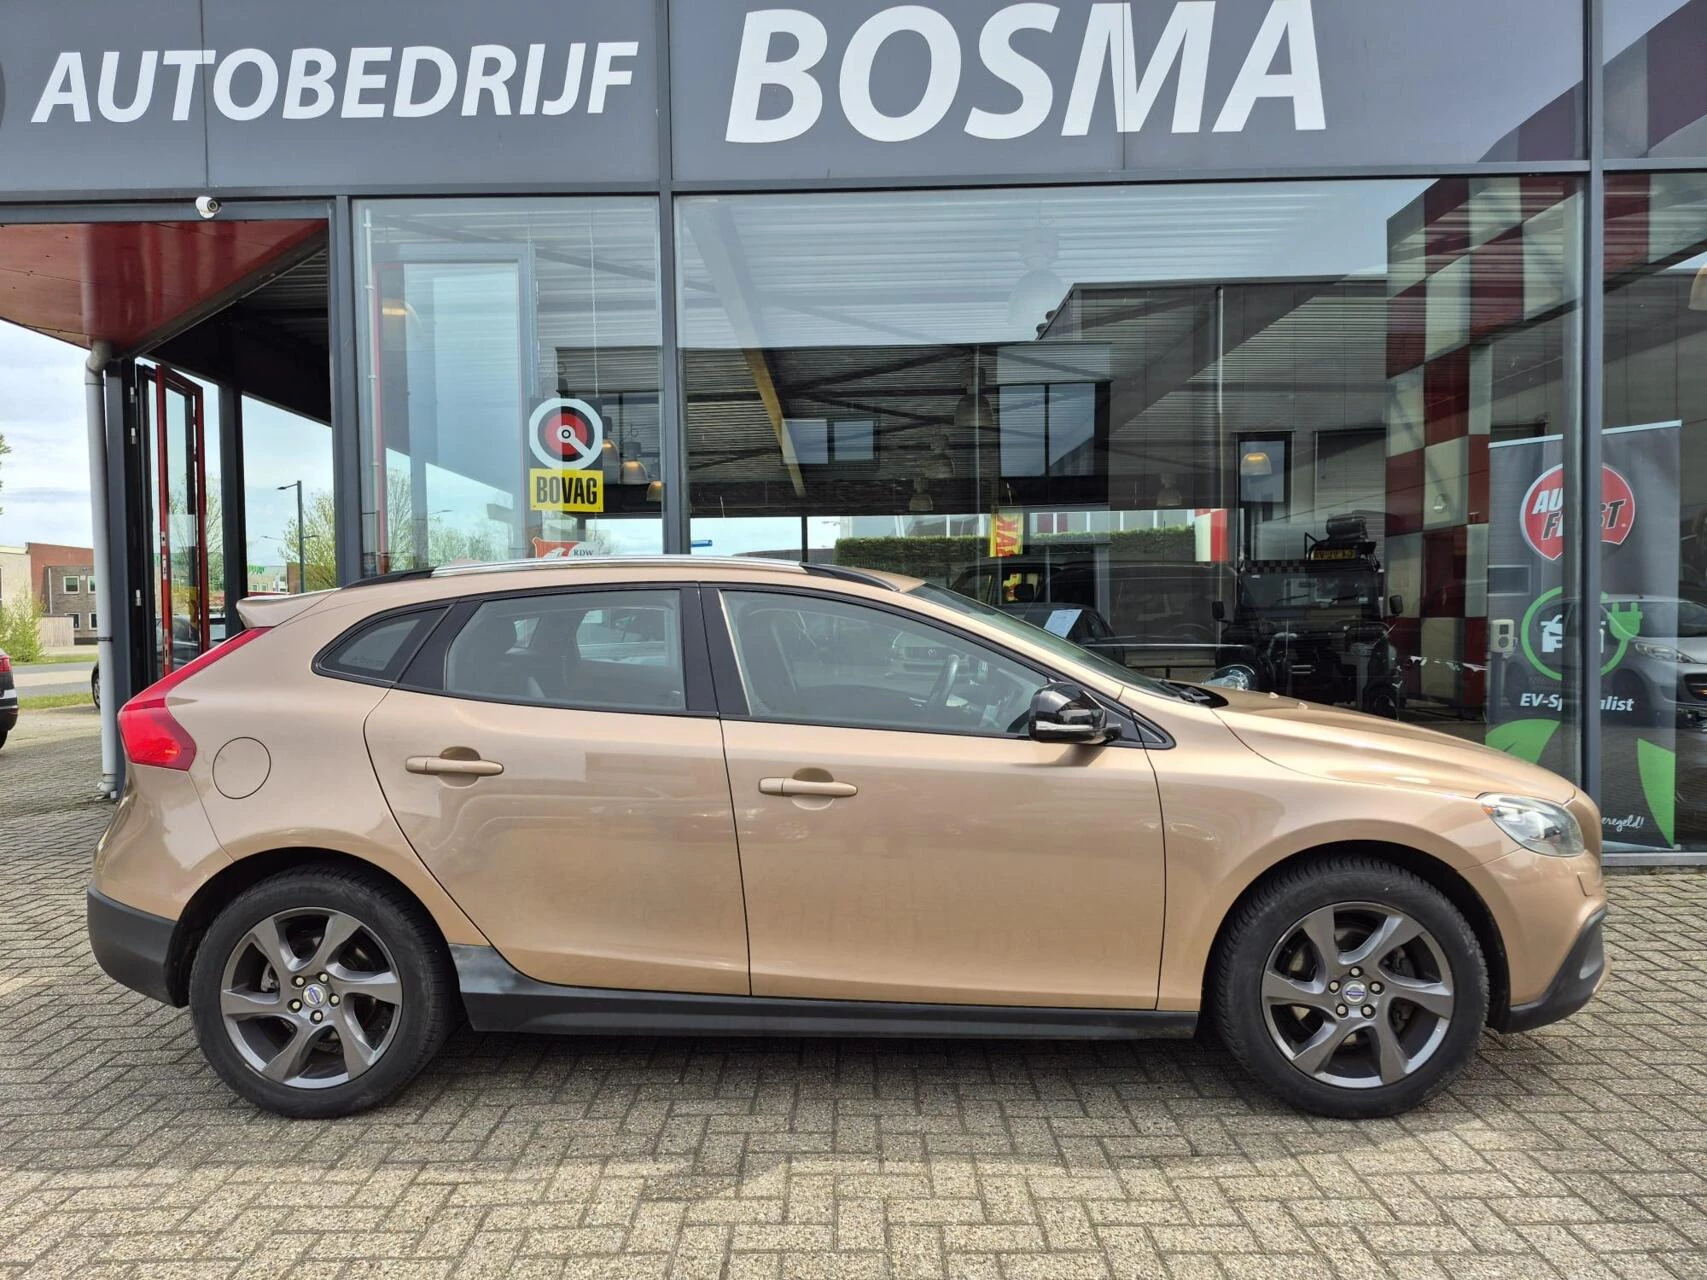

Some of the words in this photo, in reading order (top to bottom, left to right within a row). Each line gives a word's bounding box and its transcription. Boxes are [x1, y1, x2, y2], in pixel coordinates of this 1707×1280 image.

[31, 41, 640, 123] AUTOBEDRIJF
[725, 0, 1326, 143] BOSMA
[536, 476, 598, 505] BOVAG
[573, 549, 593, 557] RDW
[1600, 814, 1645, 833] eregeld!
